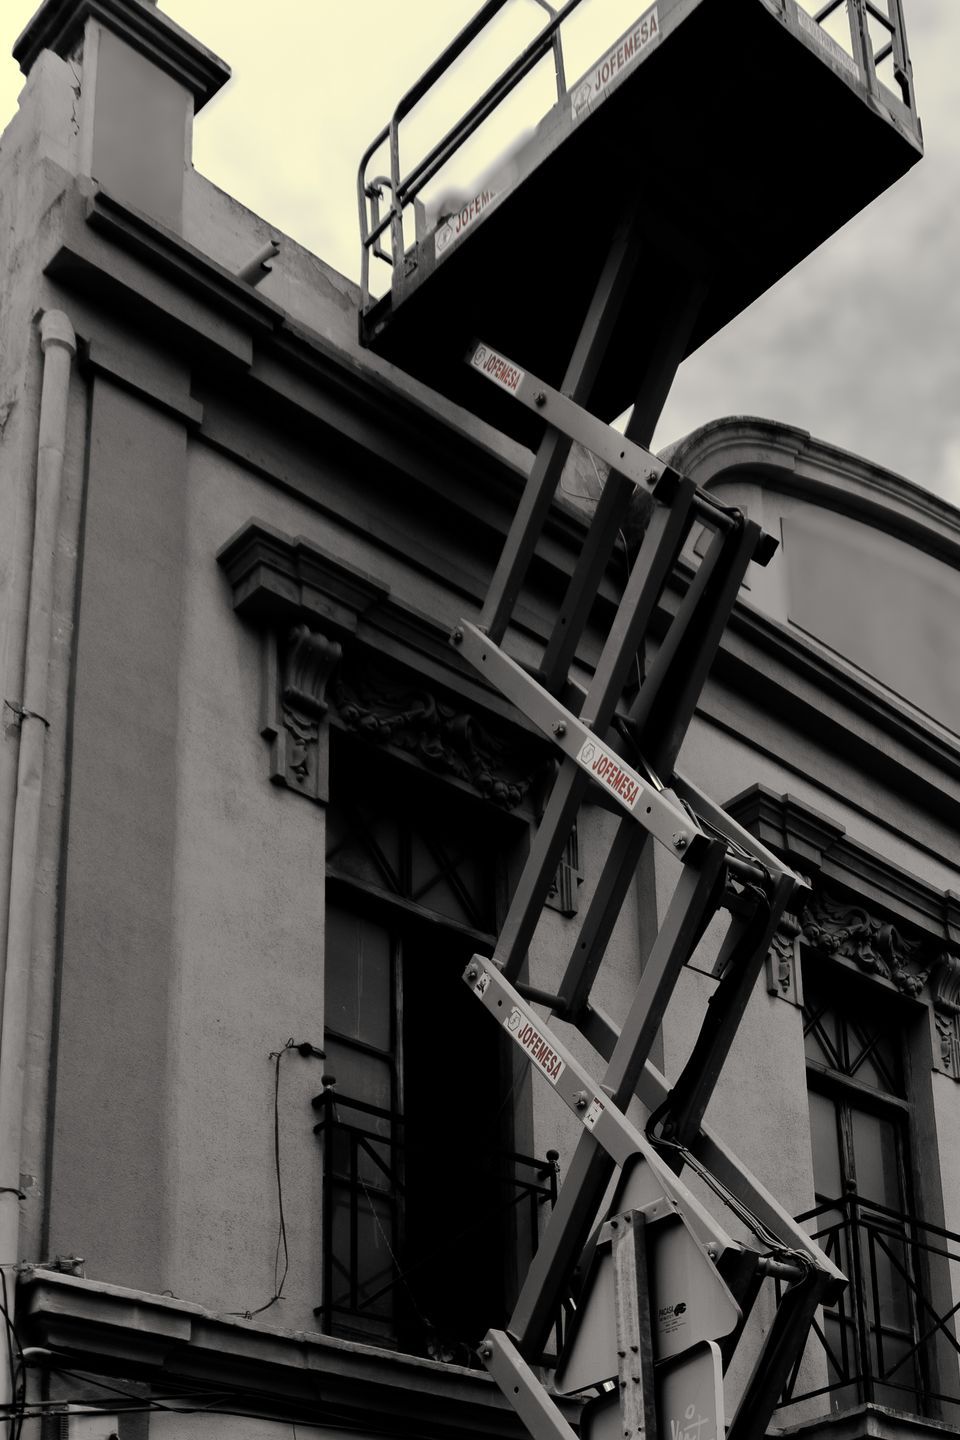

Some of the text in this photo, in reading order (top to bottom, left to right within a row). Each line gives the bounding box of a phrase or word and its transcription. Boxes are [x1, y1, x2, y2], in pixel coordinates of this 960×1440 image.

[595, 15, 657, 91] JOFEMESA
[483, 353, 522, 391] JOFEMESA
[592, 753, 640, 806] JOFEMESA
[517, 1023, 563, 1080] JOFEMESA
